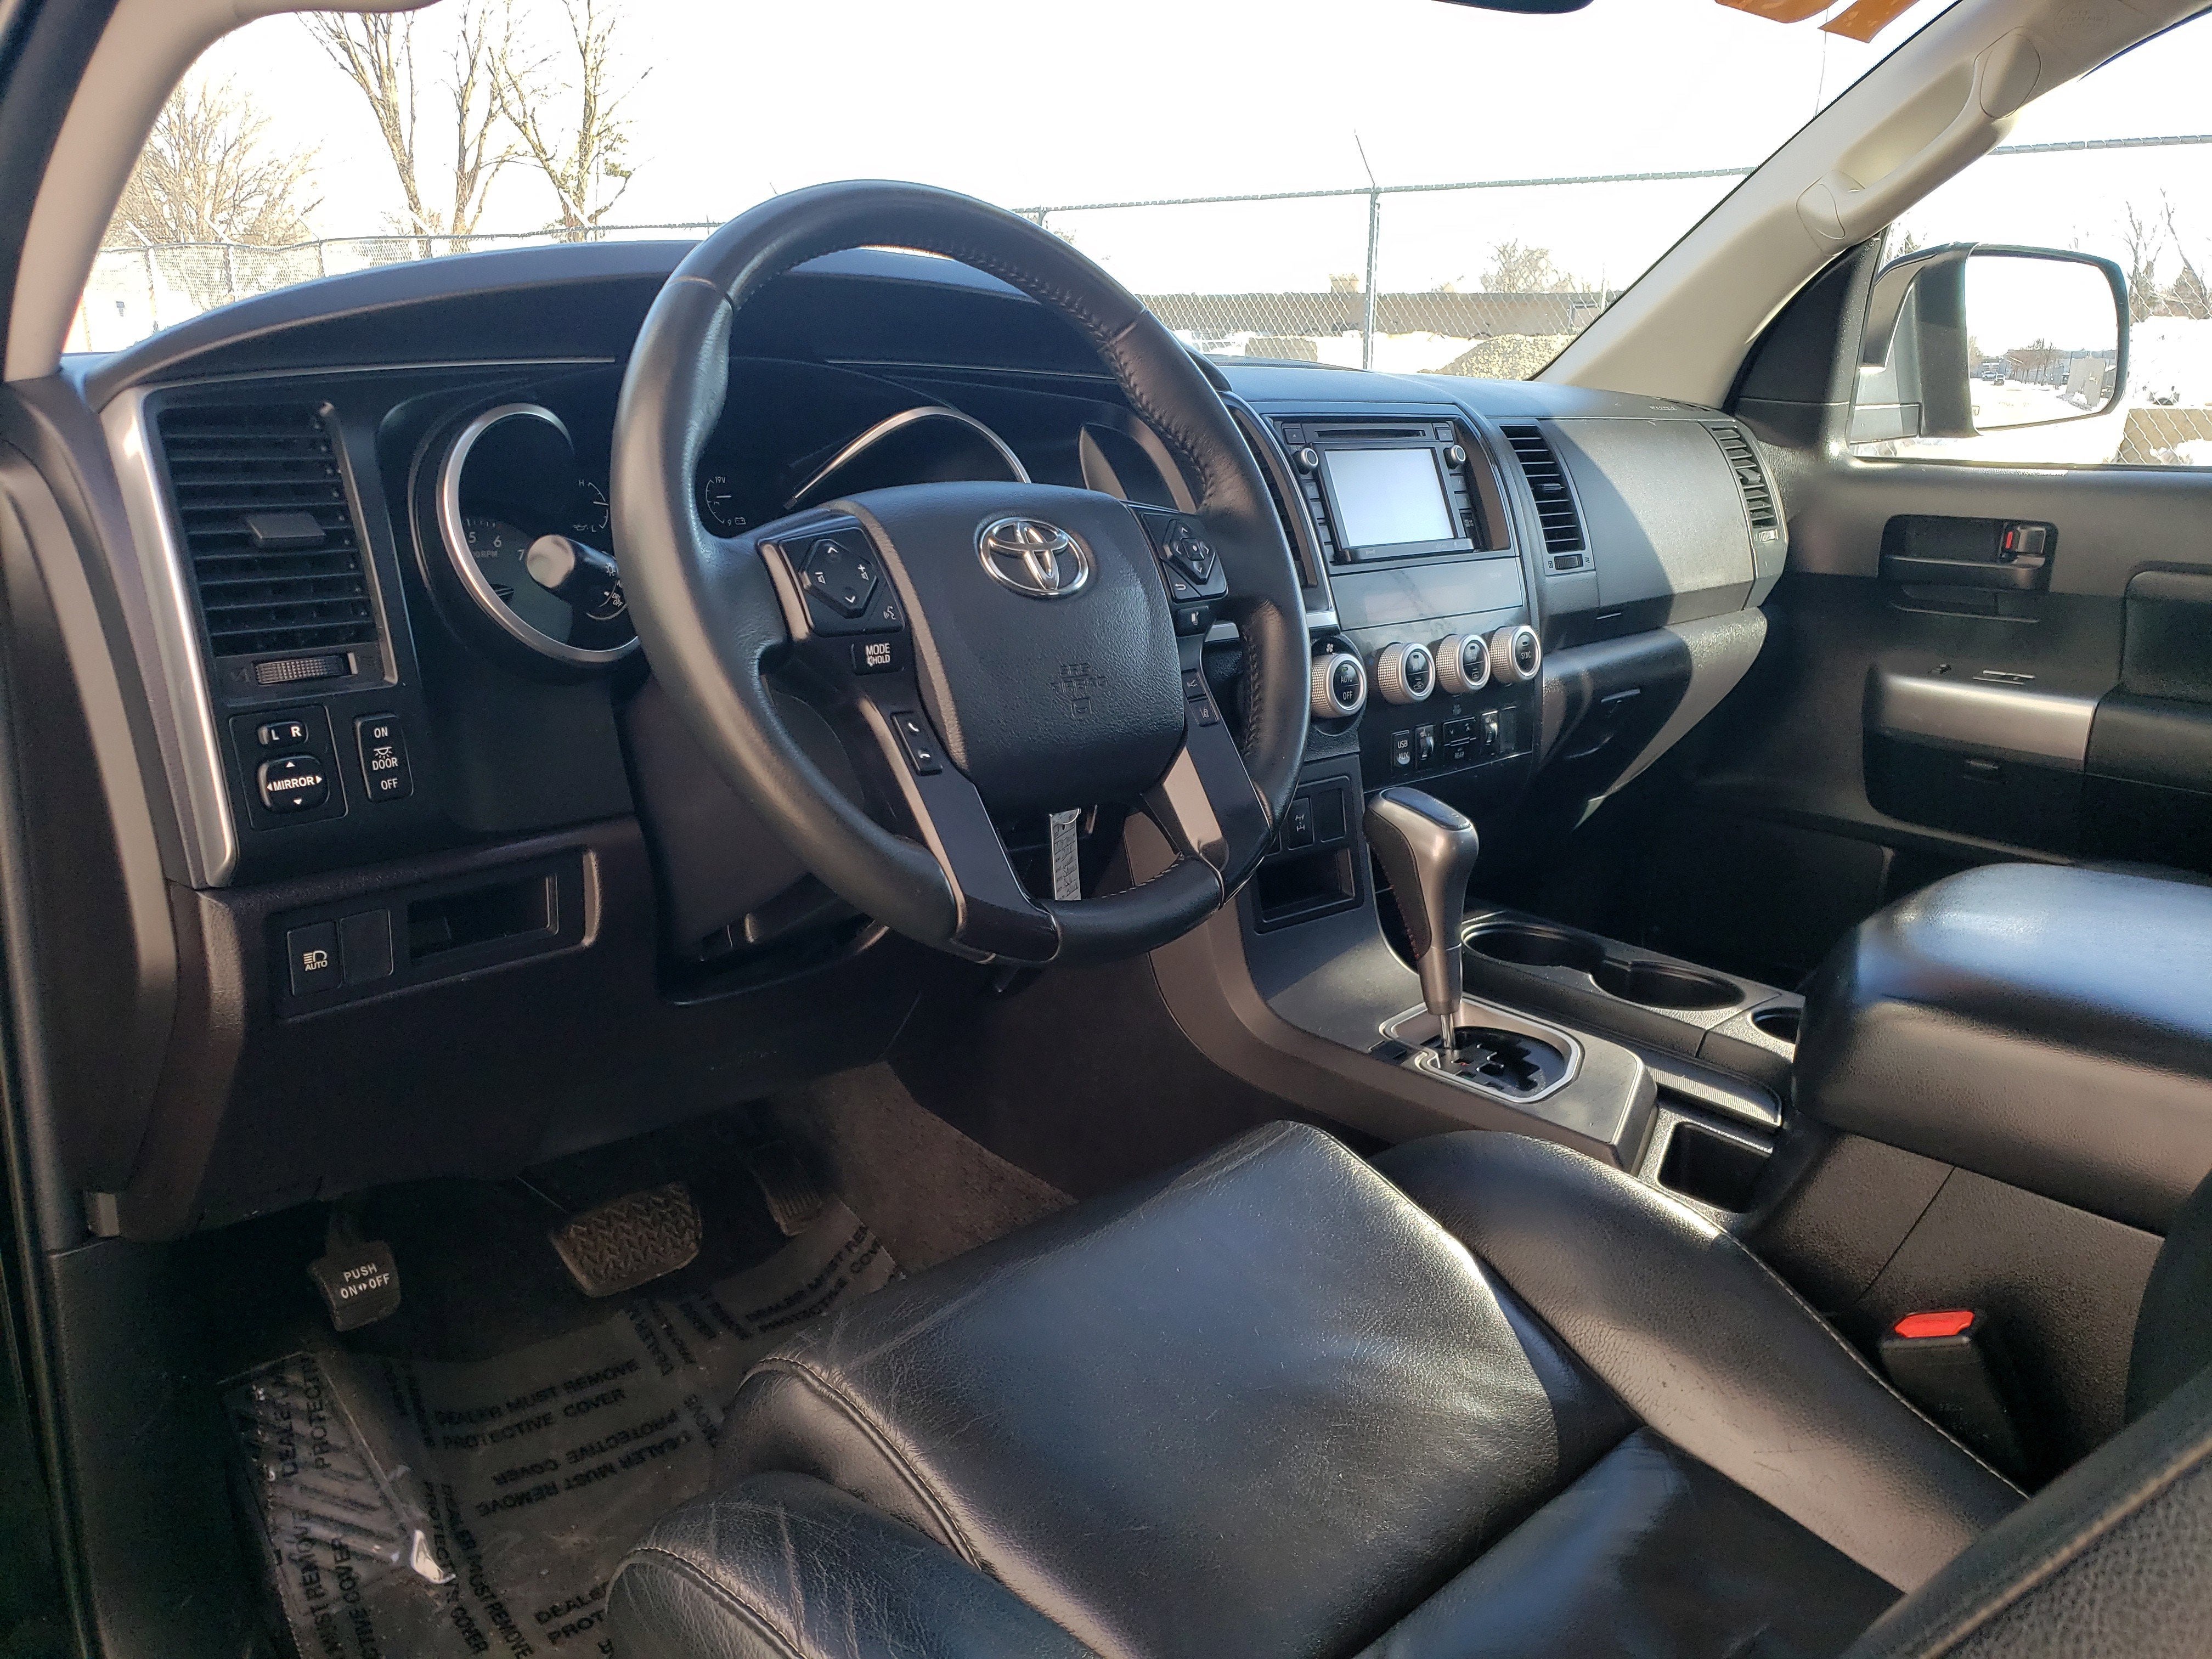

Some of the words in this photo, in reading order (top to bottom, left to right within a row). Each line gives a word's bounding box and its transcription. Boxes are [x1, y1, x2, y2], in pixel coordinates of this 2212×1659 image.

[468, 532, 477, 544] 5
[494, 534, 502, 548] 6
[517, 549, 525, 561] 7
[866, 643, 891, 656] MODE
[1521, 652, 1532, 660] SYNC
[873, 654, 890, 664] HOLD
[1342, 691, 1353, 701] OFF
[270, 729, 279, 741] L
[290, 725, 302, 737] R
[373, 727, 388, 739] ON
[1397, 740, 1409, 749] USB
[372, 756, 398, 770] DOOR
[273, 775, 315, 791] MIRROR
[380, 778, 398, 791] OFF
[304, 959, 328, 972] AUTO
[343, 1262, 379, 1282] PUSH
[340, 1285, 358, 1300] ON
[368, 1273, 391, 1291] OFF
[563, 1358, 639, 1393] REMOVE
[562, 1387, 625, 1417] COVER
[547, 1609, 604, 1644] PROT
